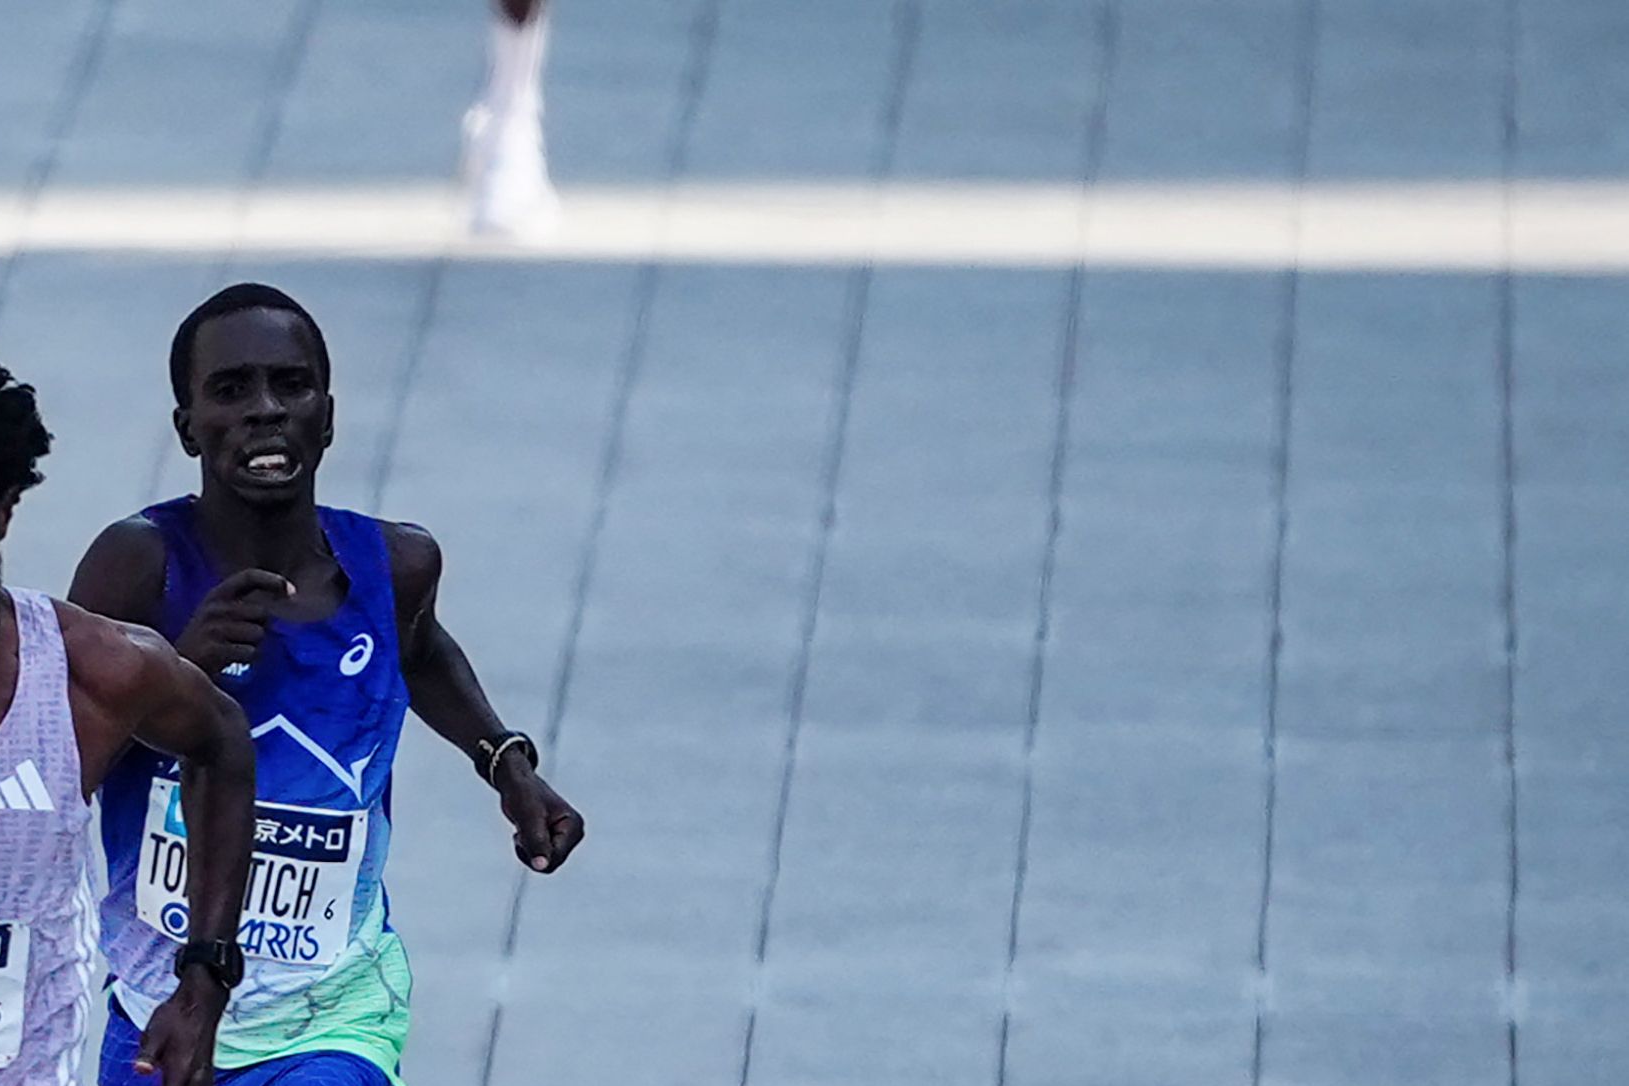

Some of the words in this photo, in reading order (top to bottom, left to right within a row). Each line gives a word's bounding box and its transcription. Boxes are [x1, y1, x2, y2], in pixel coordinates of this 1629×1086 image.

[254, 818, 345, 850] 京メトロ
[323, 898, 337, 921] 6
